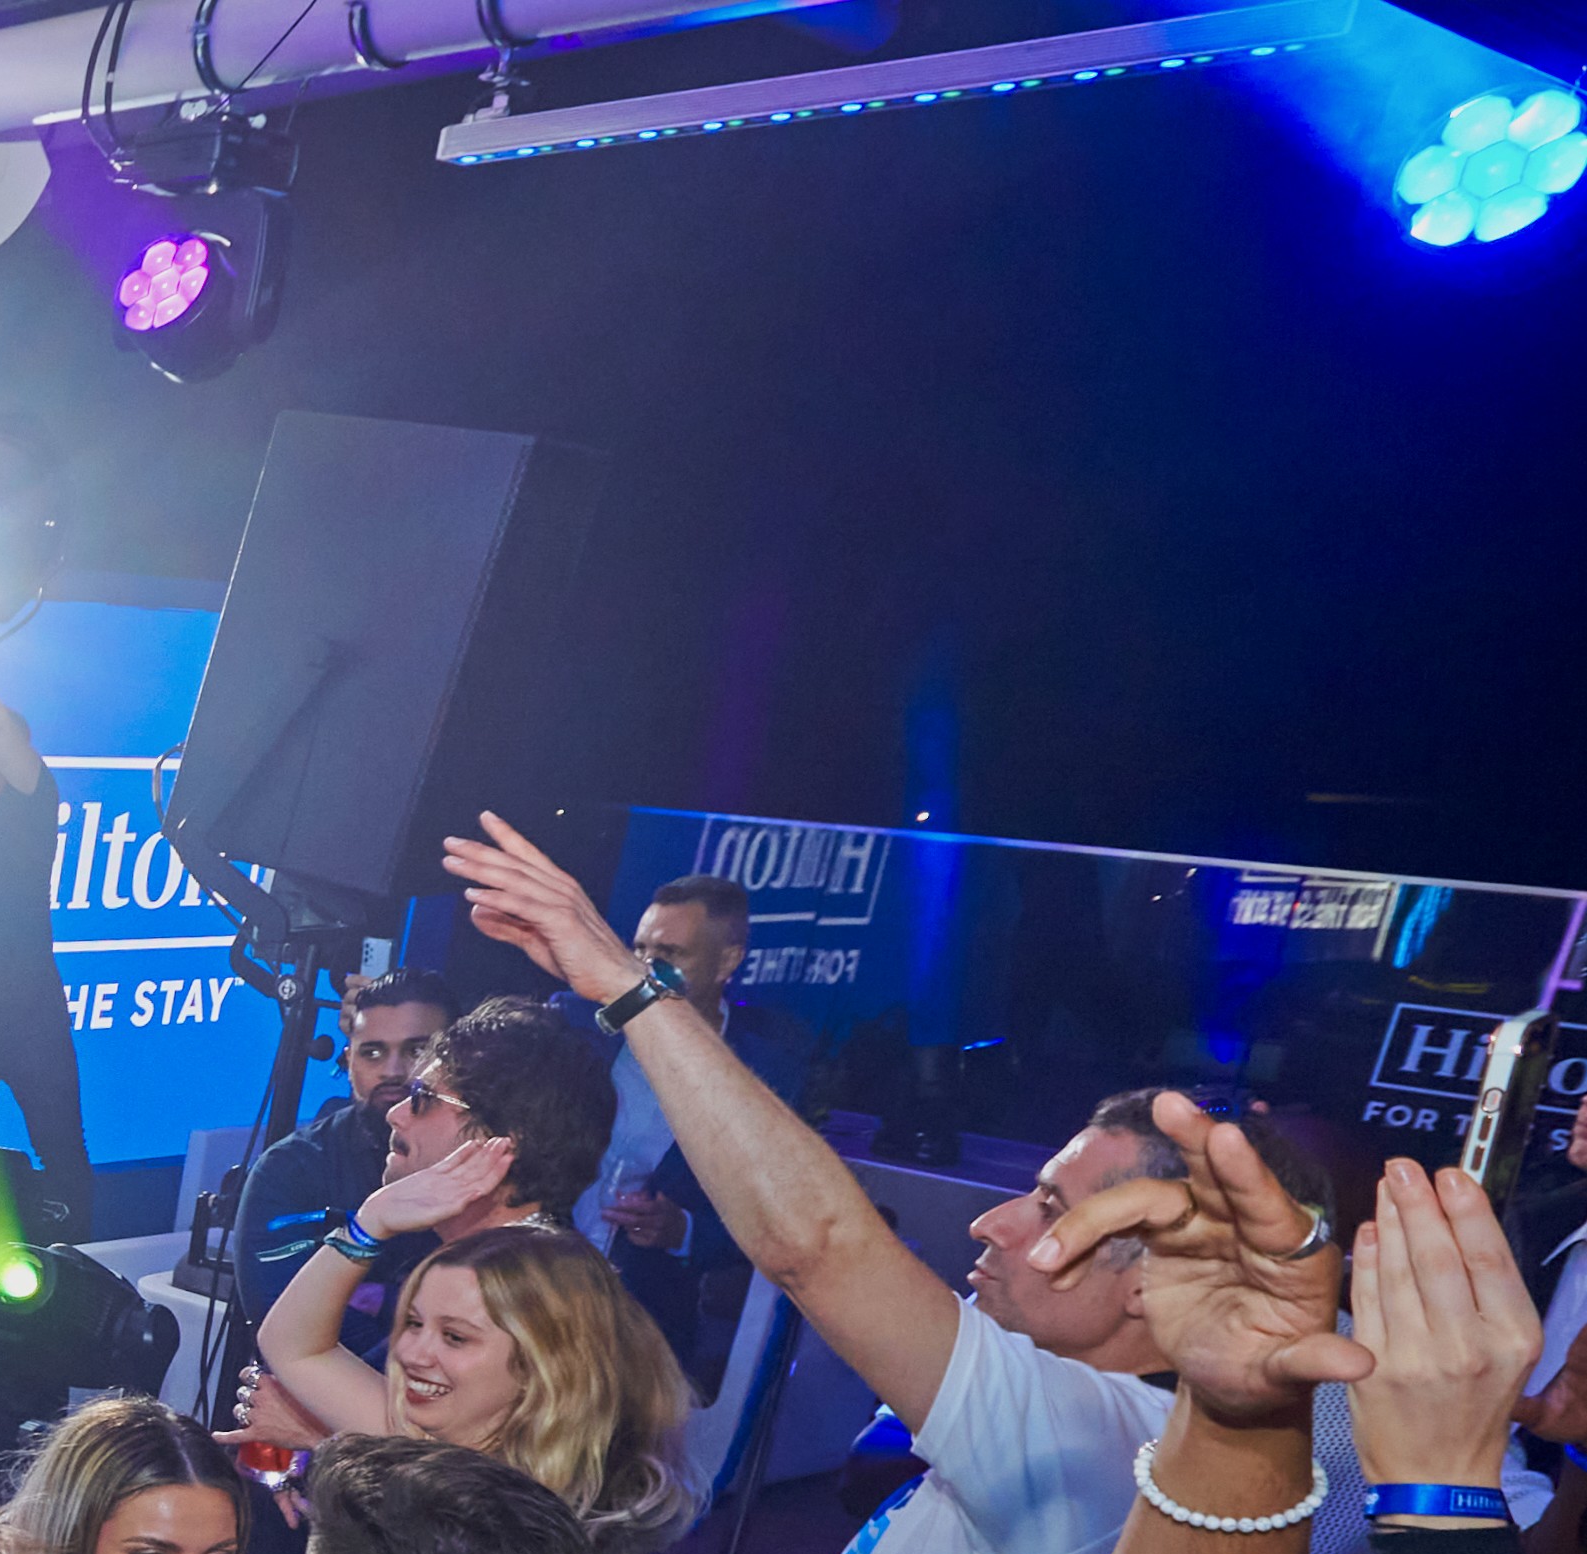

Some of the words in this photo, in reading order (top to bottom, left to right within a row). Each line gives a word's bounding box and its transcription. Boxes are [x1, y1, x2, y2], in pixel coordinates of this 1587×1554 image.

[50, 802, 228, 909] ilto
[63, 982, 120, 1030] HE
[1362, 1101, 1440, 1132] FOR
